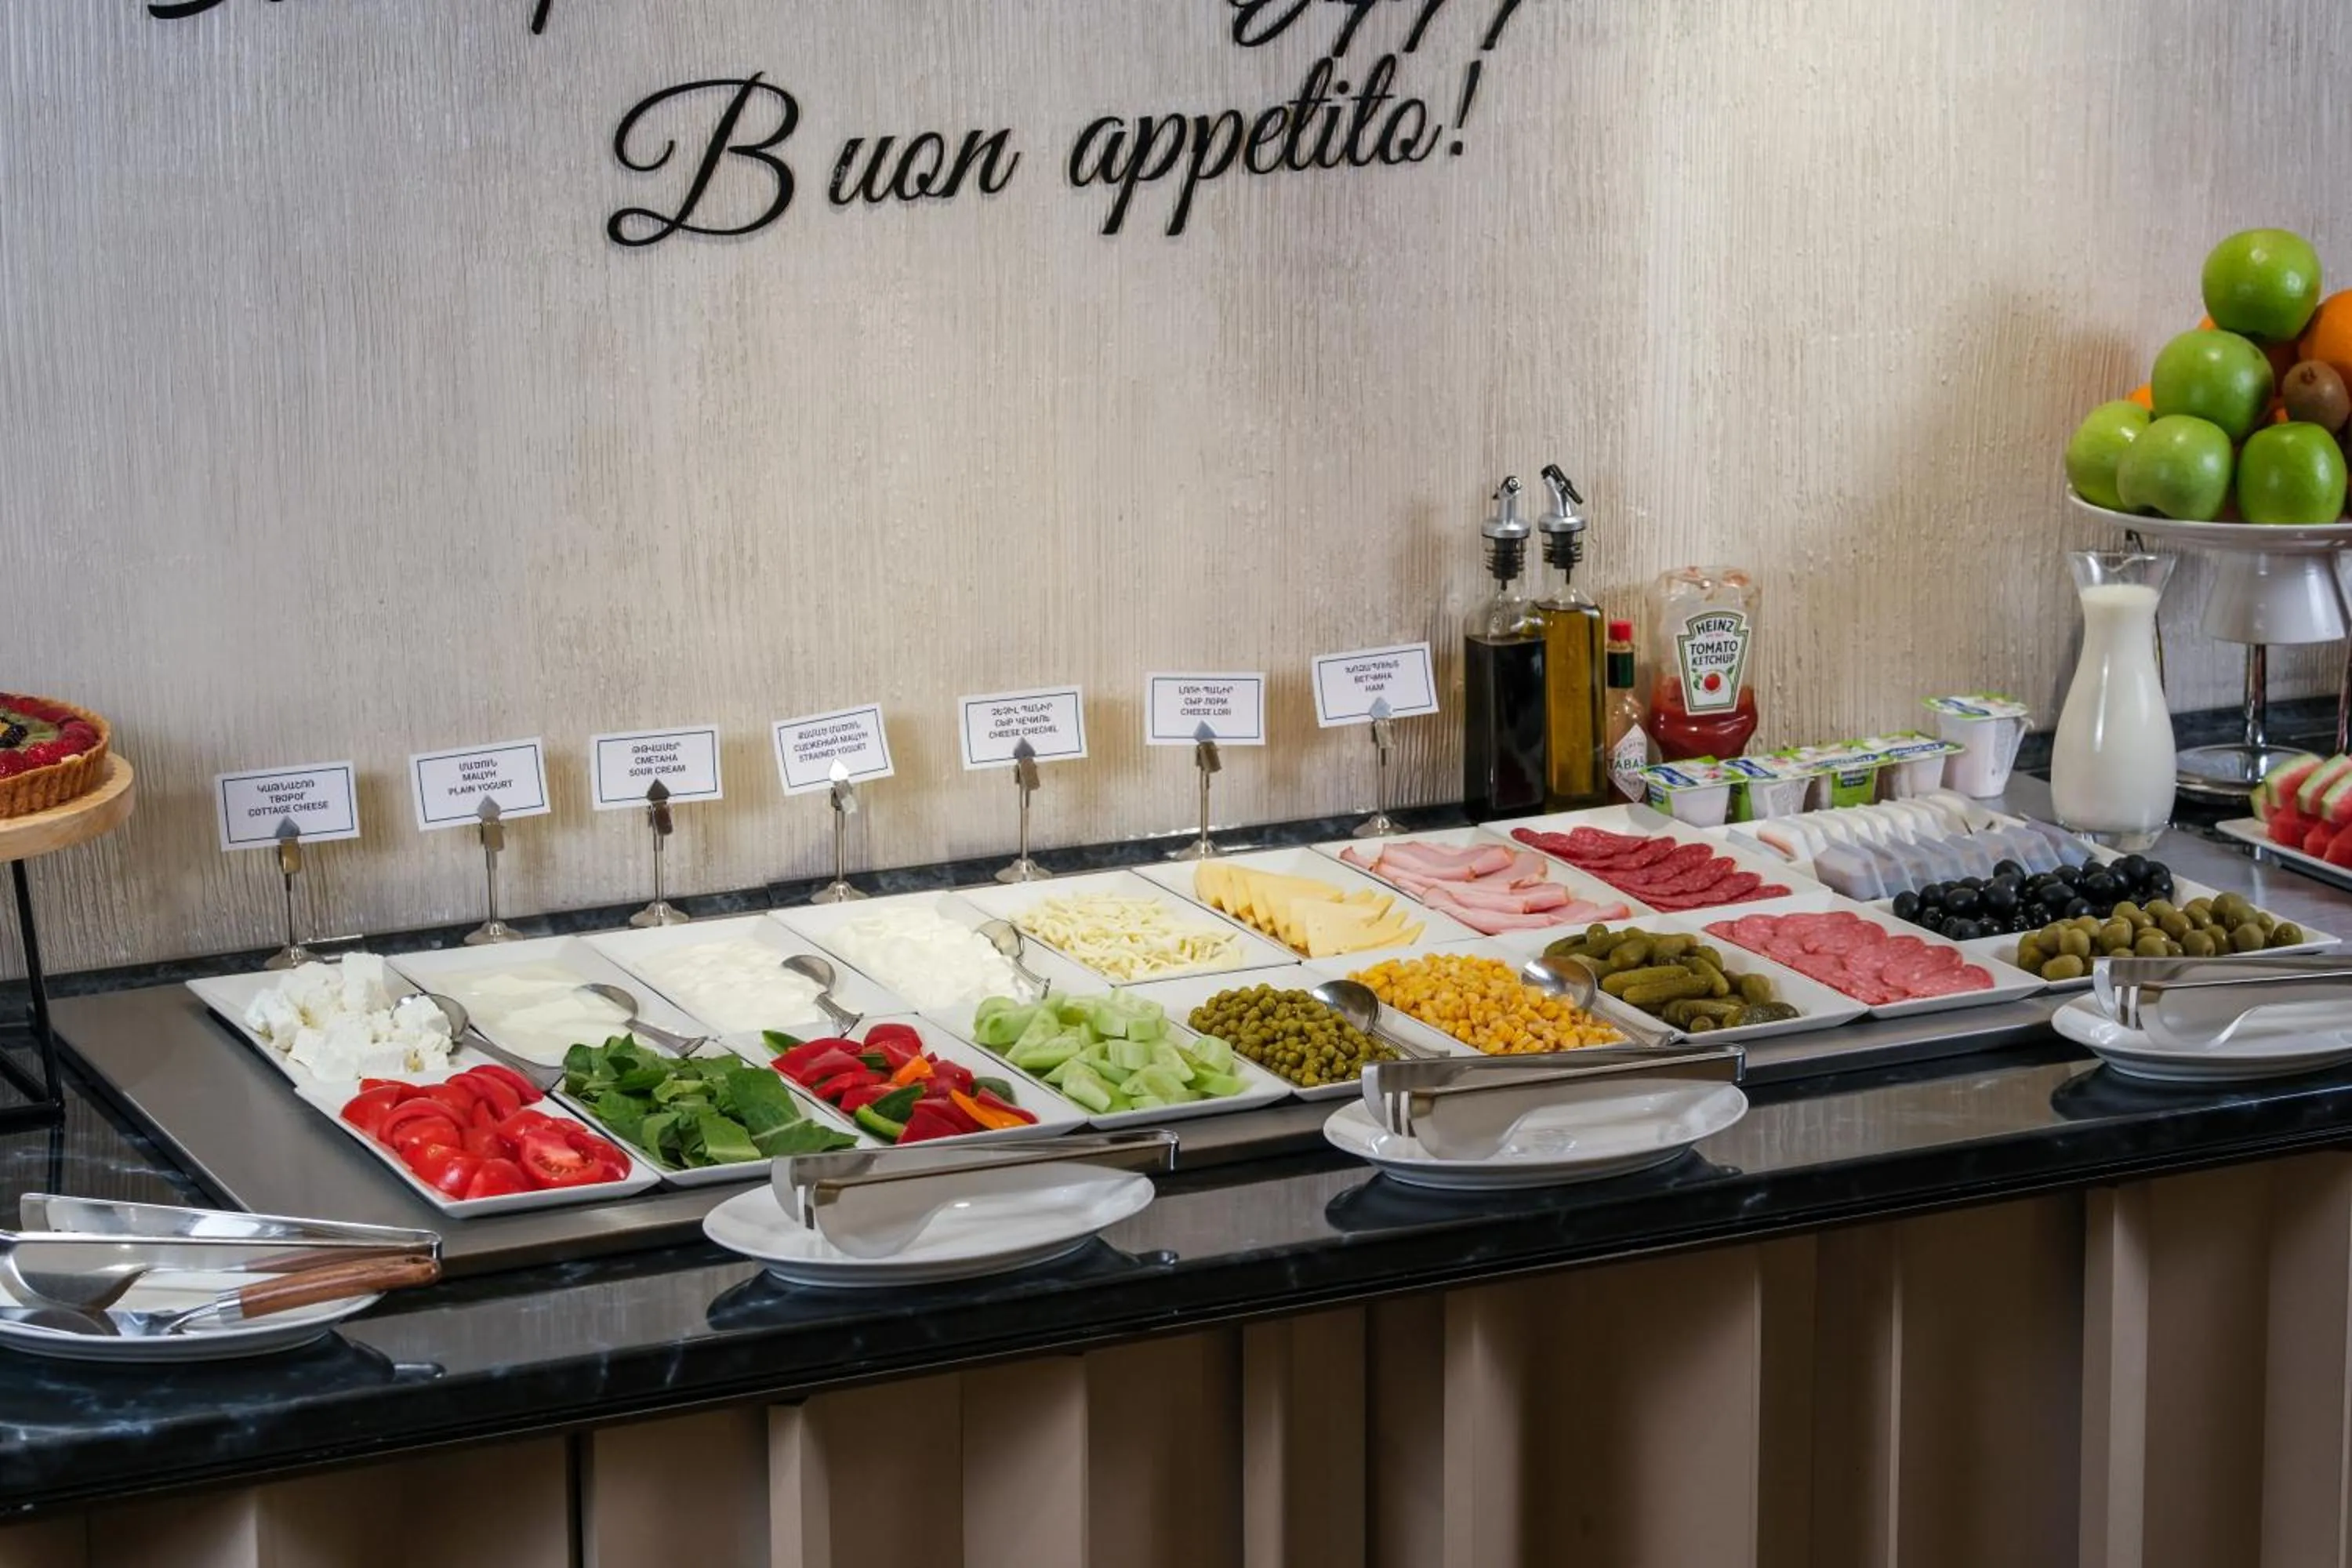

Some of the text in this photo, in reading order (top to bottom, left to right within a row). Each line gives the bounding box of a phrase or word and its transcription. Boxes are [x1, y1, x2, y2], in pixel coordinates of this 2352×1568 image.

[608, 55, 1480, 248] Buon appetito!
[1696, 619, 1734, 635] HEINZ
[1690, 641, 1738, 655] TOMATO
[1692, 654, 1736, 666] KETCHUP
[995, 717, 1014, 727] СЫР
[989, 728, 1020, 739] CHEESE
[799, 742, 866, 762] STRAINED YOGURT
[634, 754, 678, 764] СМЕТАНА
[463, 770, 496, 781] МАЦУН
[629, 764, 685, 776] SOUR CREAM
[448, 780, 513, 796] PLAIN YOGURT
[269, 792, 306, 804] ТВОРОГ
[248, 800, 328, 818] COTTAGE CHEESE
